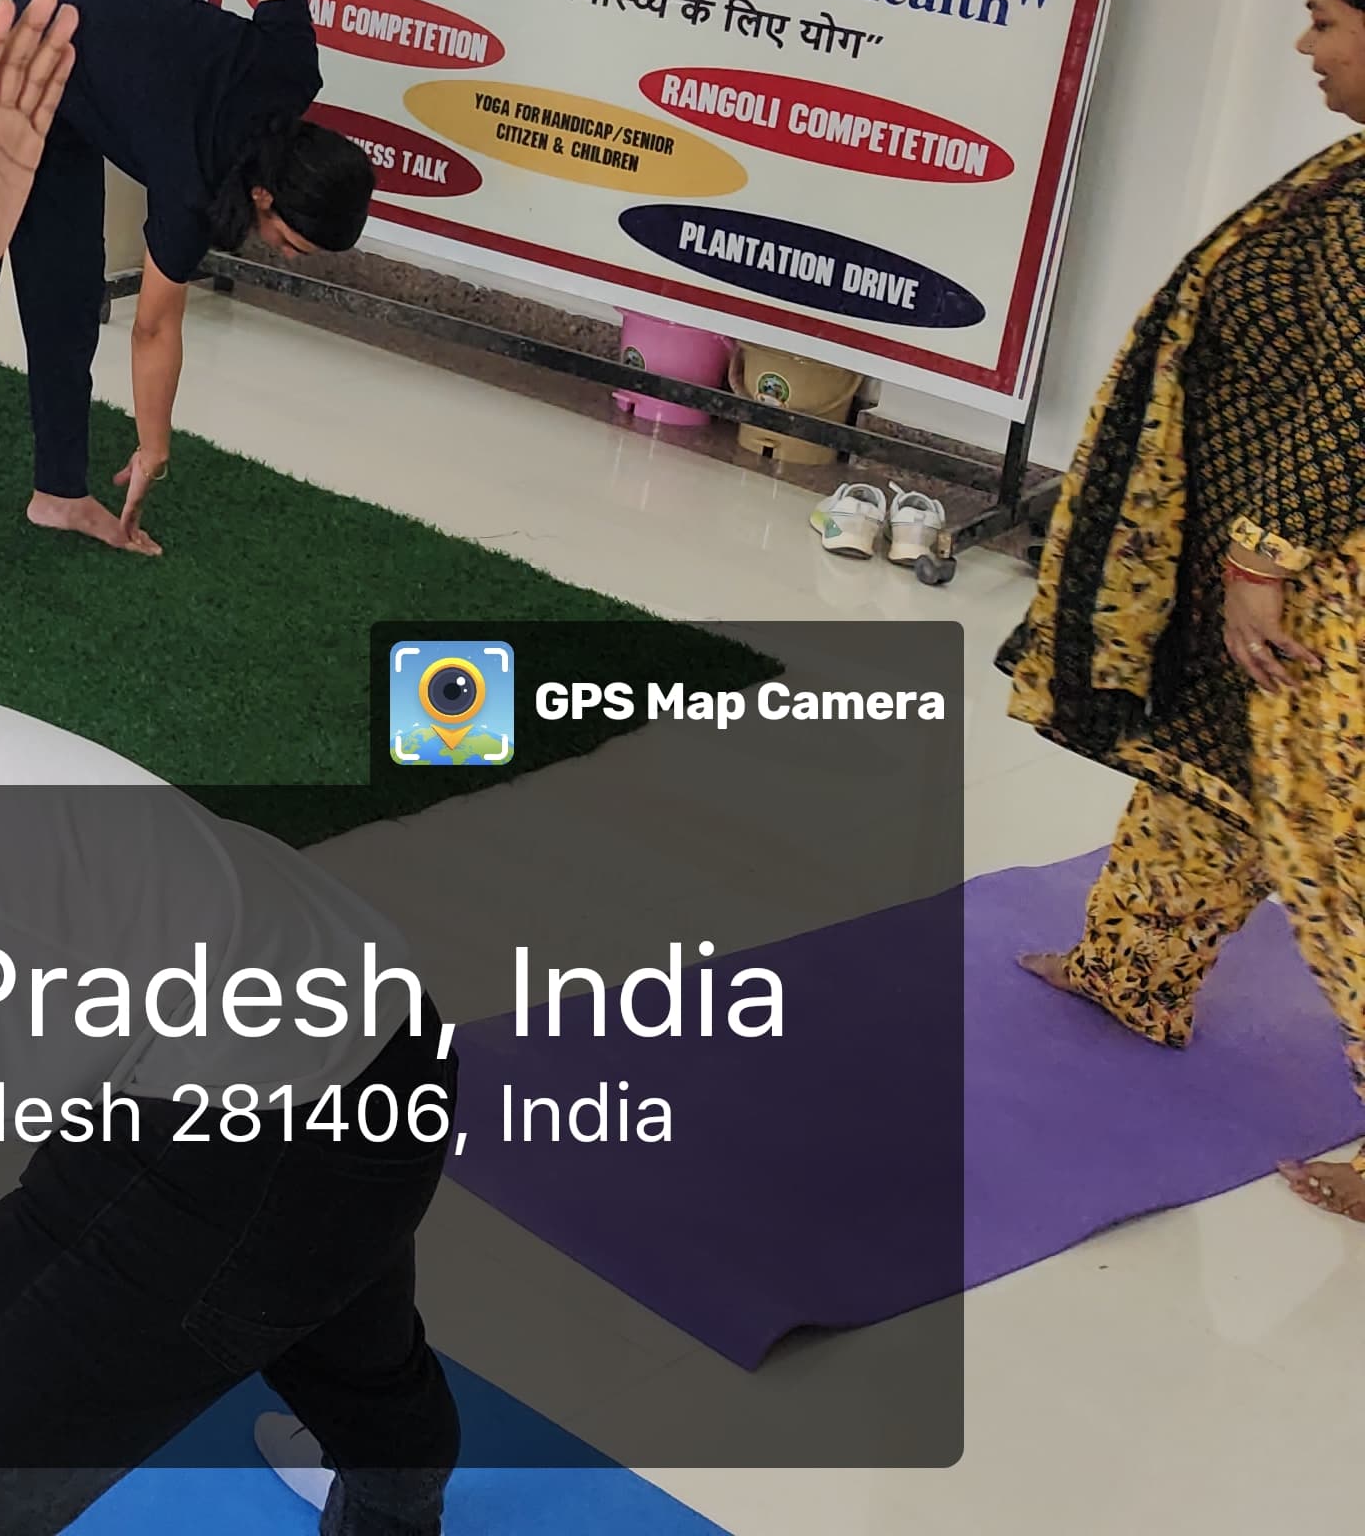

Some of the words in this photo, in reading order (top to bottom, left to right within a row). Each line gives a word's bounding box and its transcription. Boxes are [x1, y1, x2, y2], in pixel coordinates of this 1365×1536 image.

[340, 3, 490, 64] COMPETETION
[474, 92, 510, 118] YOGA
[660, 73, 782, 129] RANGOLI
[787, 103, 991, 177] COMPETETION
[401, 150, 450, 185] TALK
[495, 122, 549, 151] CITIZEN
[553, 138, 565, 155] &
[570, 142, 640, 173] CHILDREN
[678, 220, 837, 288] PLANTATION
[841, 263, 920, 311] DRIVE
